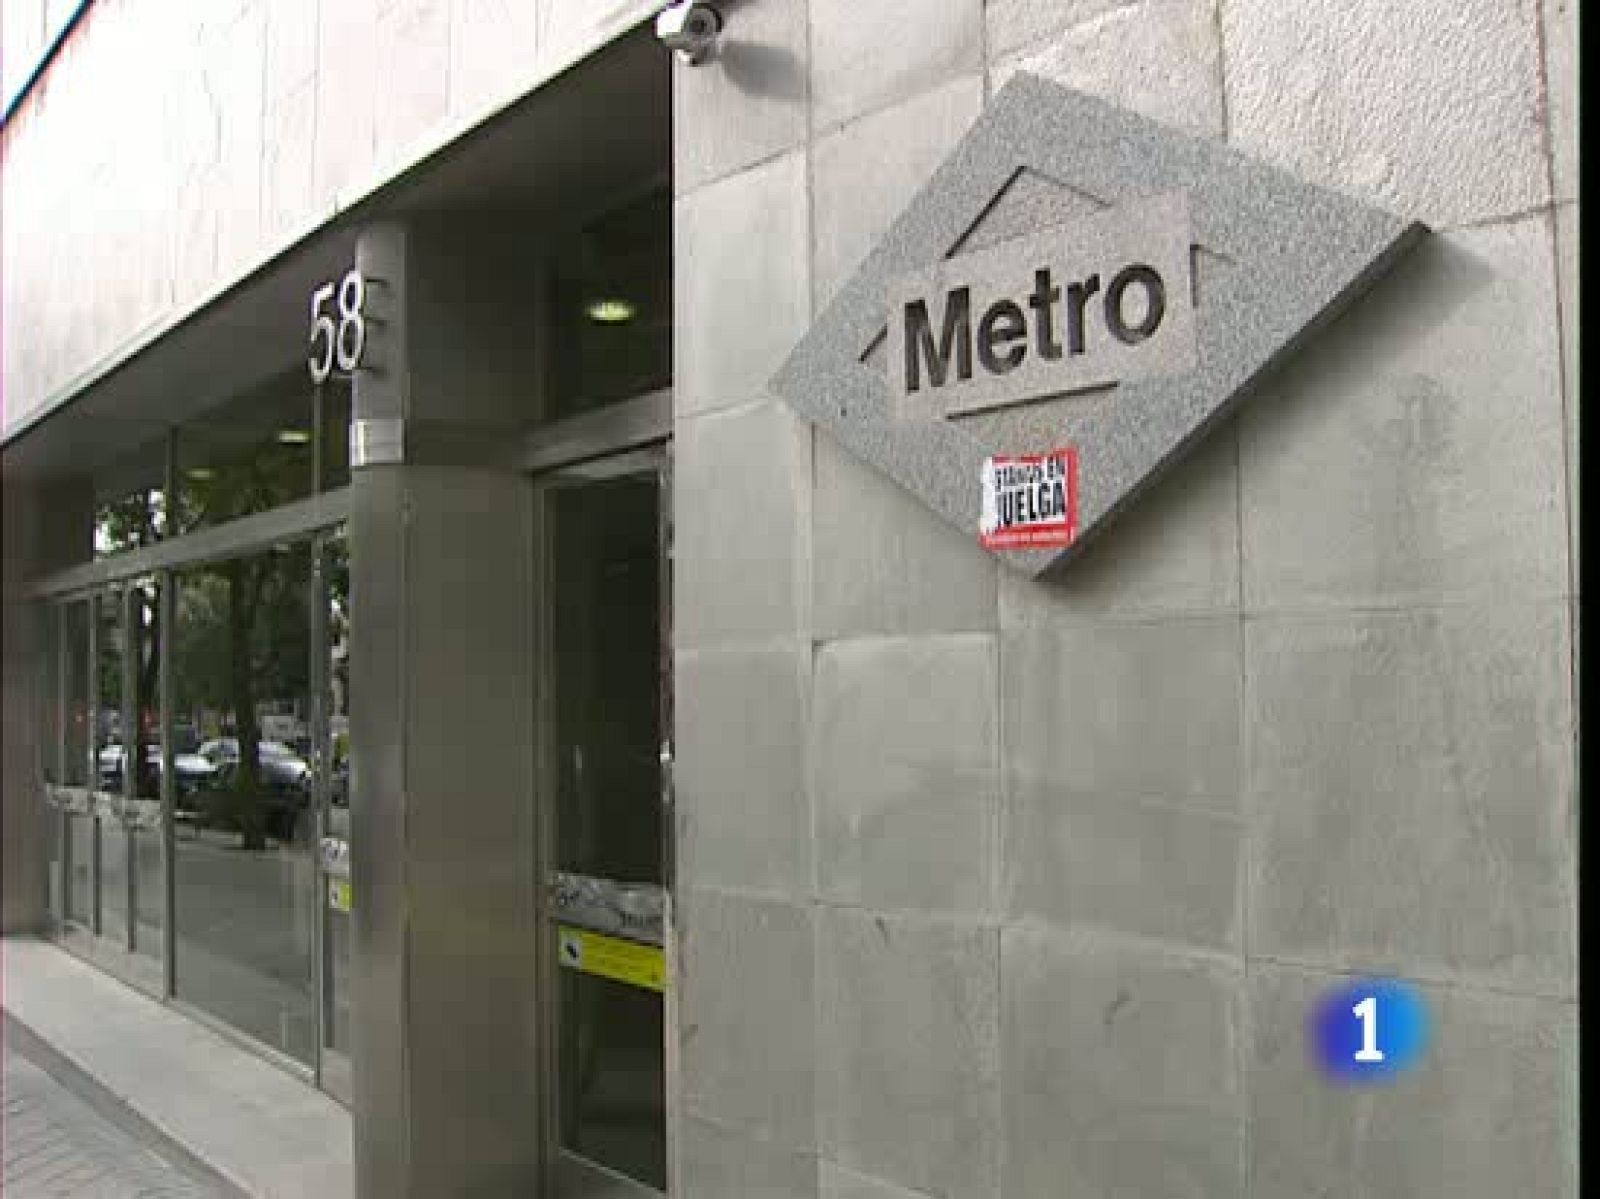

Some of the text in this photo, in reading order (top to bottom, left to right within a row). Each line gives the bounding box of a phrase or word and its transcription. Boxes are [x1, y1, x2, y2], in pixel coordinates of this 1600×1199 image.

[309, 270, 364, 384] 58
[904, 262, 1165, 394] Metro
[994, 465, 1043, 491] STAMOS
